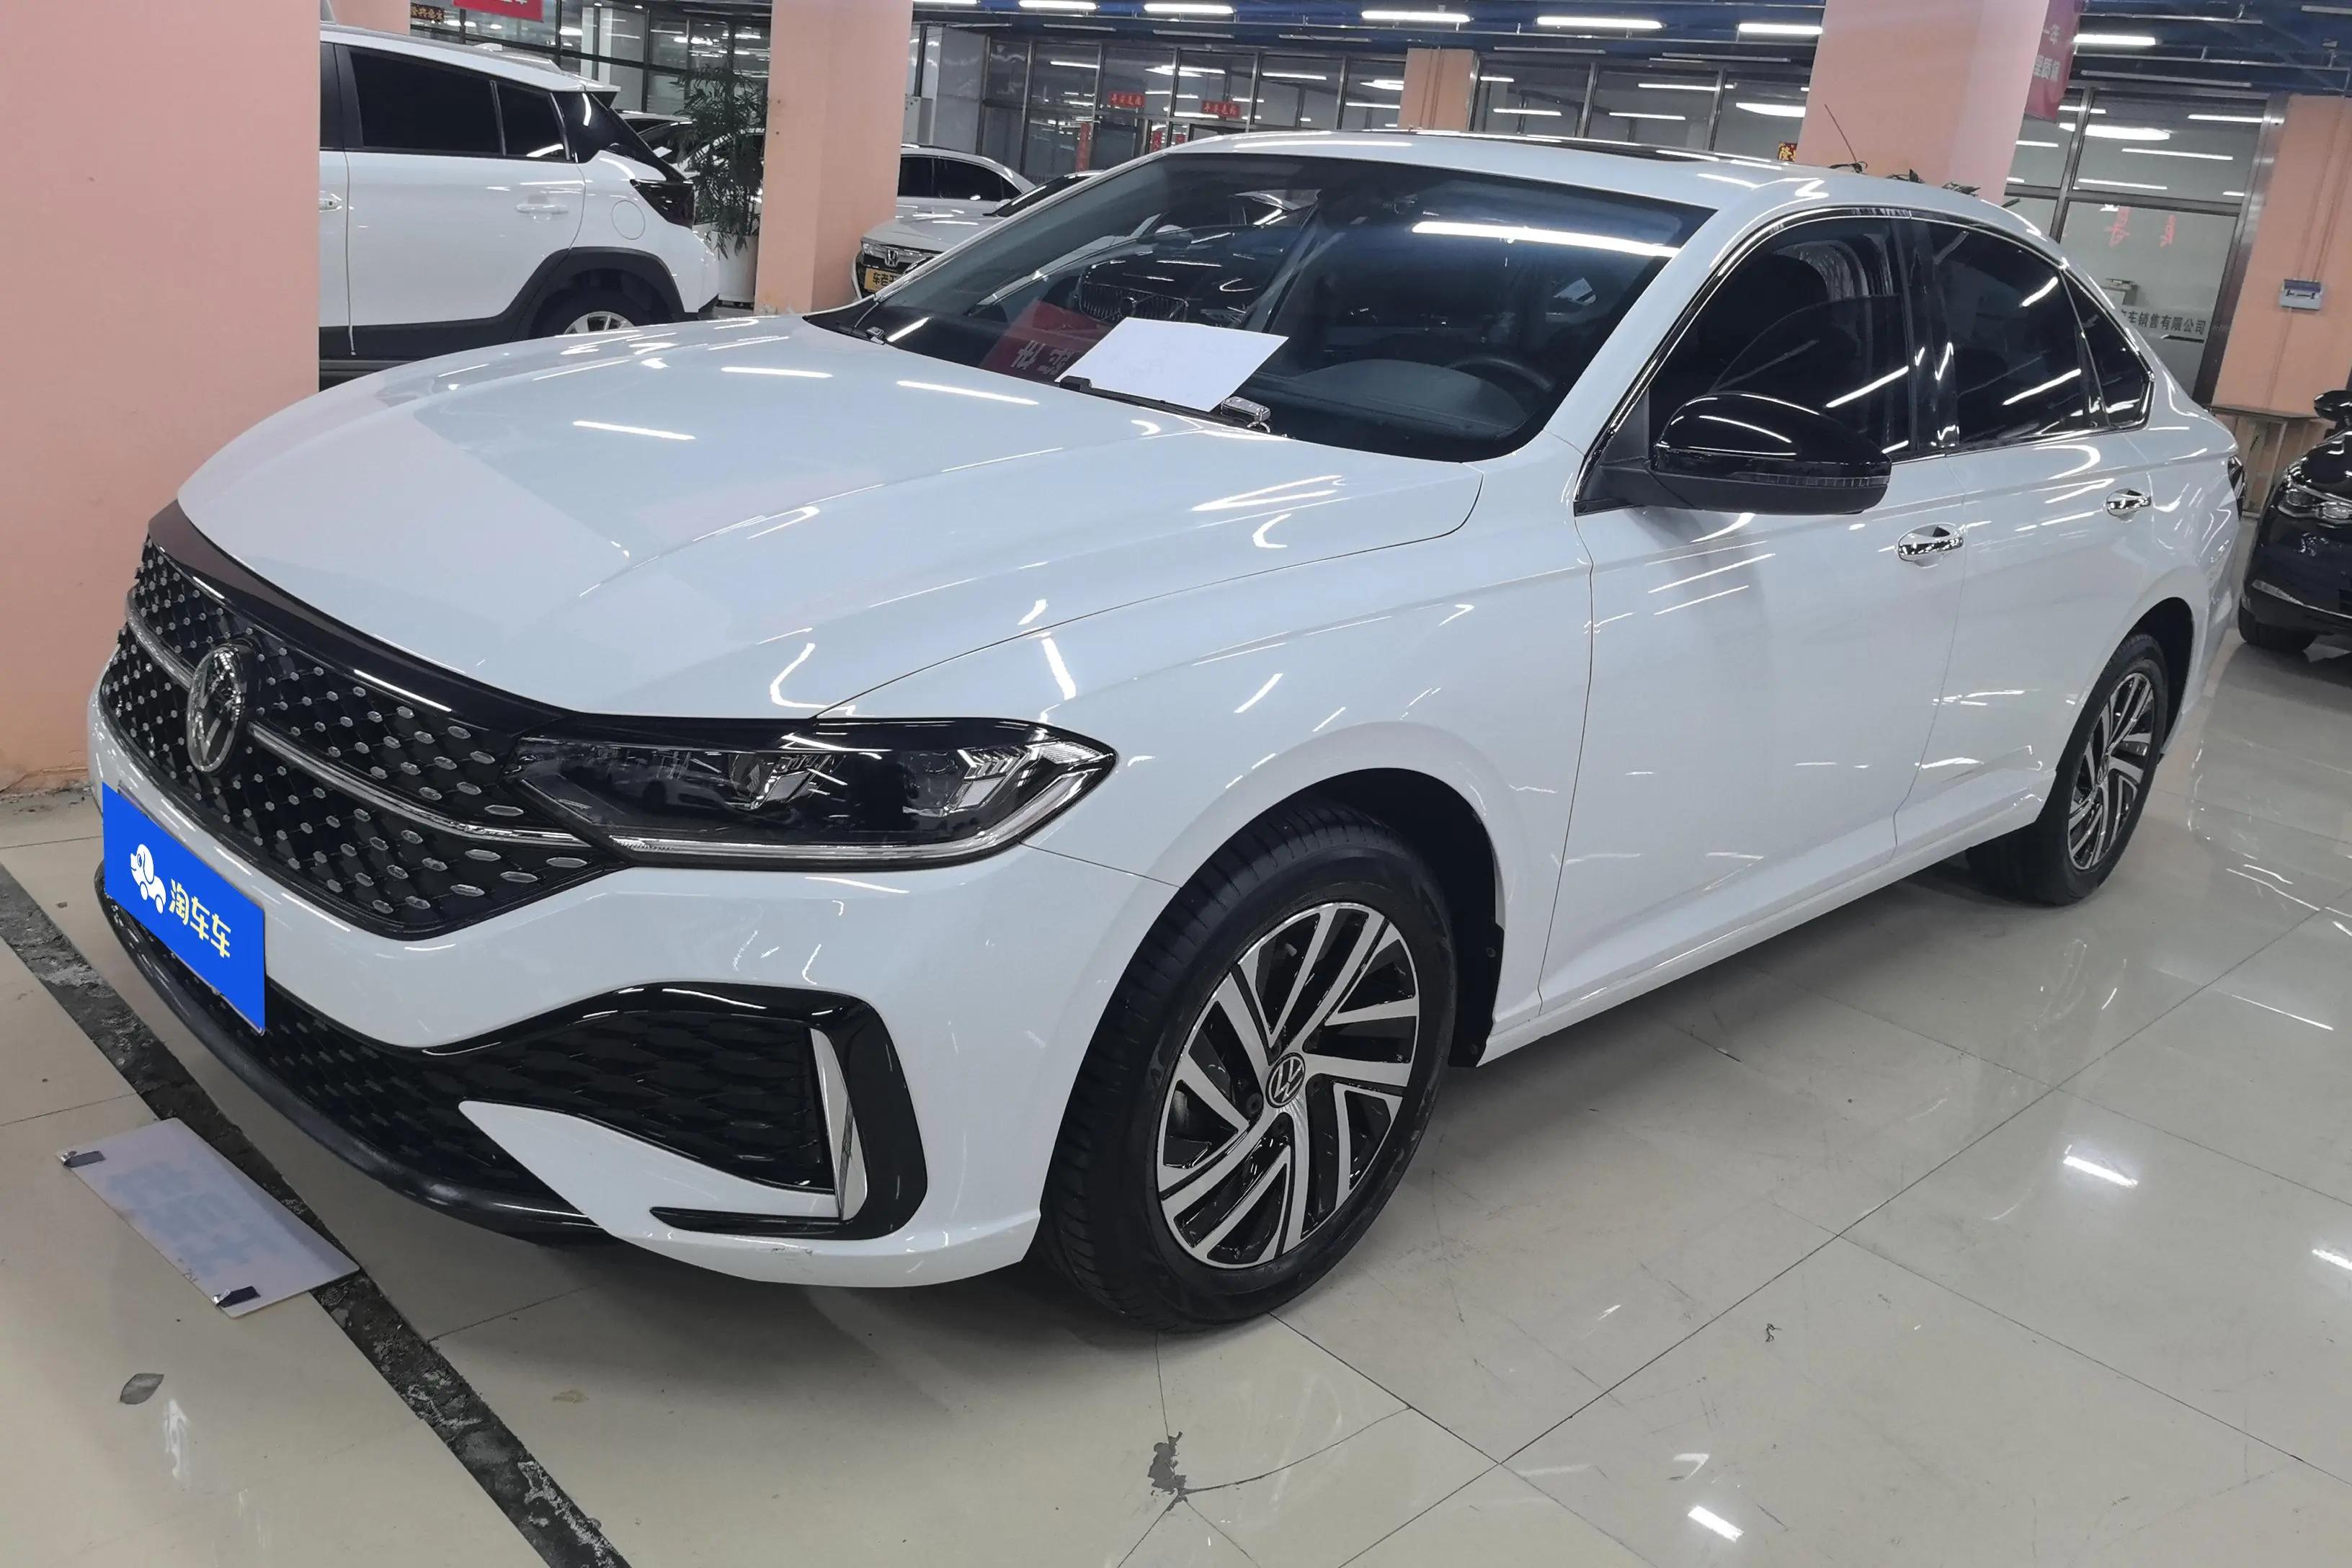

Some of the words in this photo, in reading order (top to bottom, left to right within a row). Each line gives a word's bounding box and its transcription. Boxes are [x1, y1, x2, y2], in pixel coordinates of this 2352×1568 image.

[2121, 309, 2206, 335] 车销售有限公司
